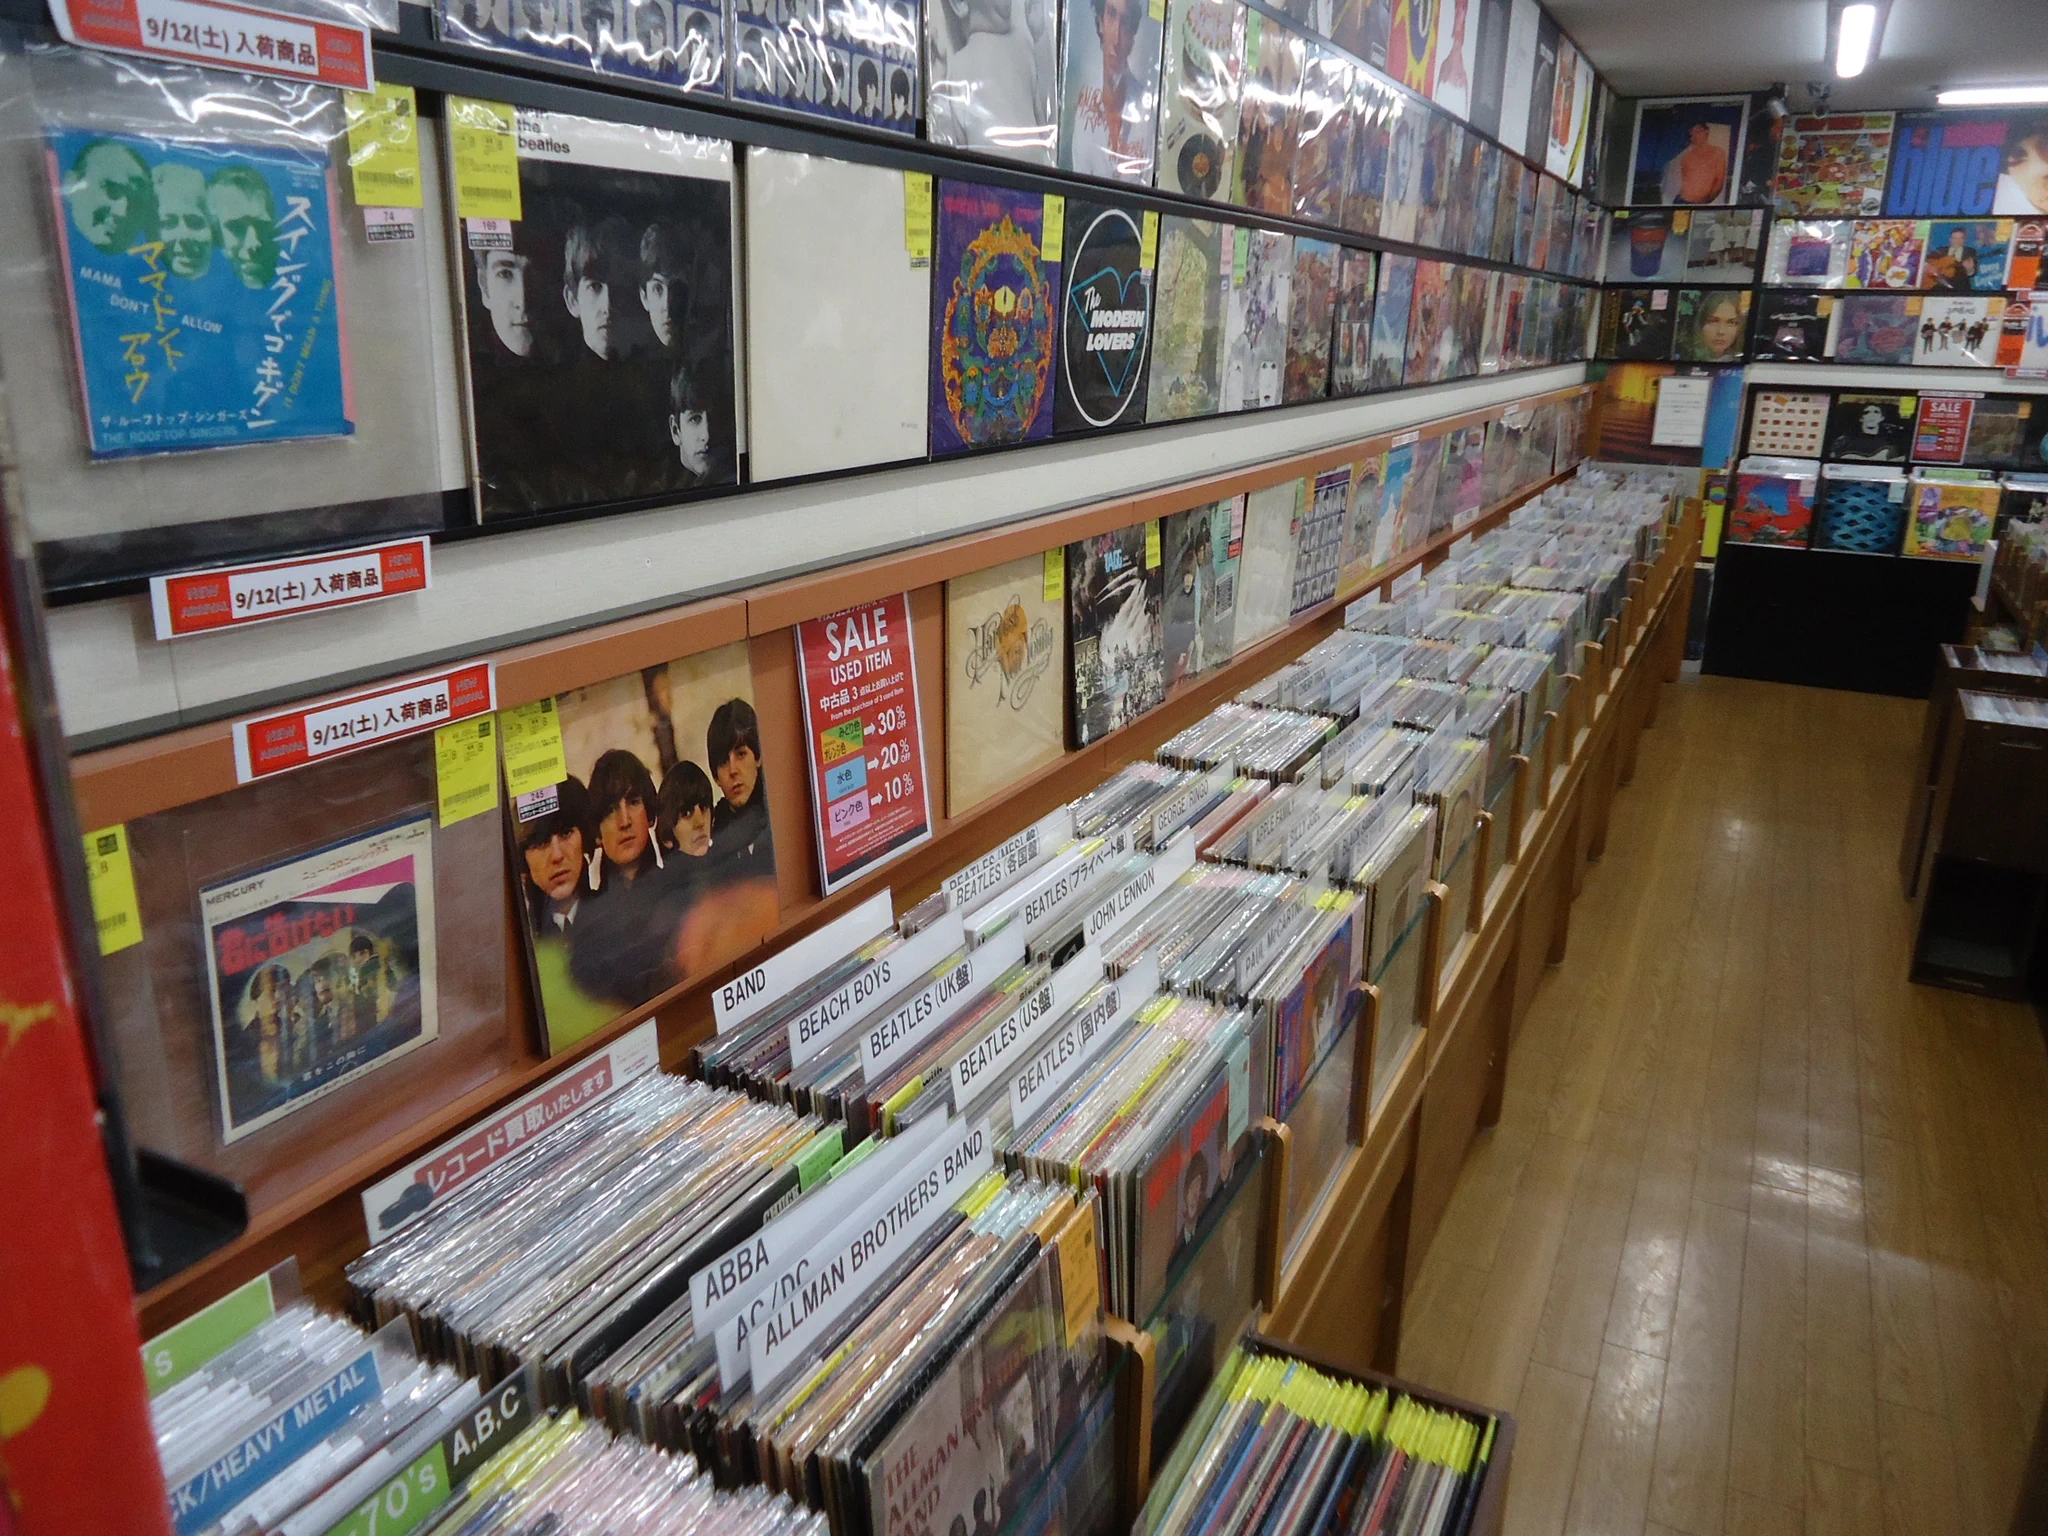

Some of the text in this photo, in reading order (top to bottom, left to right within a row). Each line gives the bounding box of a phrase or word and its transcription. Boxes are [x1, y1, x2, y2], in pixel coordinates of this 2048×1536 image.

[146, 18, 316, 67] 9/12(土) 入荷商品
[517, 119, 542, 133] the
[517, 134, 571, 154] beatles
[79, 266, 123, 290] MAMA
[1084, 285, 1102, 314] The
[109, 293, 150, 315] DON'T
[181, 314, 223, 335] ALLOW
[1089, 309, 1146, 328] MODERN
[1085, 332, 1136, 352] LOVERS
[1929, 401, 1962, 413] SALE
[235, 567, 380, 610] 9/12(土) 入荷商品
[825, 606, 889, 662] SALE
[830, 647, 893, 686] USED ITEM
[313, 693, 449, 747] 9/12(土) 入荷商品
[819, 687, 851, 713] 中古品
[852, 686, 859, 700] 3
[896, 719, 907, 730] OFF
[836, 768, 853, 786] 水色
[900, 752, 911, 763] OFF
[834, 800, 864, 823] ピンク色
[904, 785, 915, 797] OFF
[205, 878, 266, 906] MERCURY
[957, 837, 1041, 906] BEATLES (各国盤)
[1025, 830, 1128, 925] BEATLES (プライベート盤)
[1089, 866, 1156, 936] JOHN LENNON
[722, 968, 767, 1012] BAND
[798, 960, 892, 1044] BEACH BOYS
[870, 959, 975, 1059] BEATLES (UK盤)
[959, 981, 1056, 1087] BEATLES (US盤)
[1018, 985, 1122, 1103] BEATLES (国内盤)
[426, 1068, 607, 1192] レコード買取いたします
[765, 1129, 984, 1357] ALLMAN BROTHERS BAND
[705, 1237, 770, 1309] ABBA
[293, 1365, 366, 1429] METAL
[886, 1440, 918, 1498] THE
[889, 1424, 960, 1535] ALLMAN
